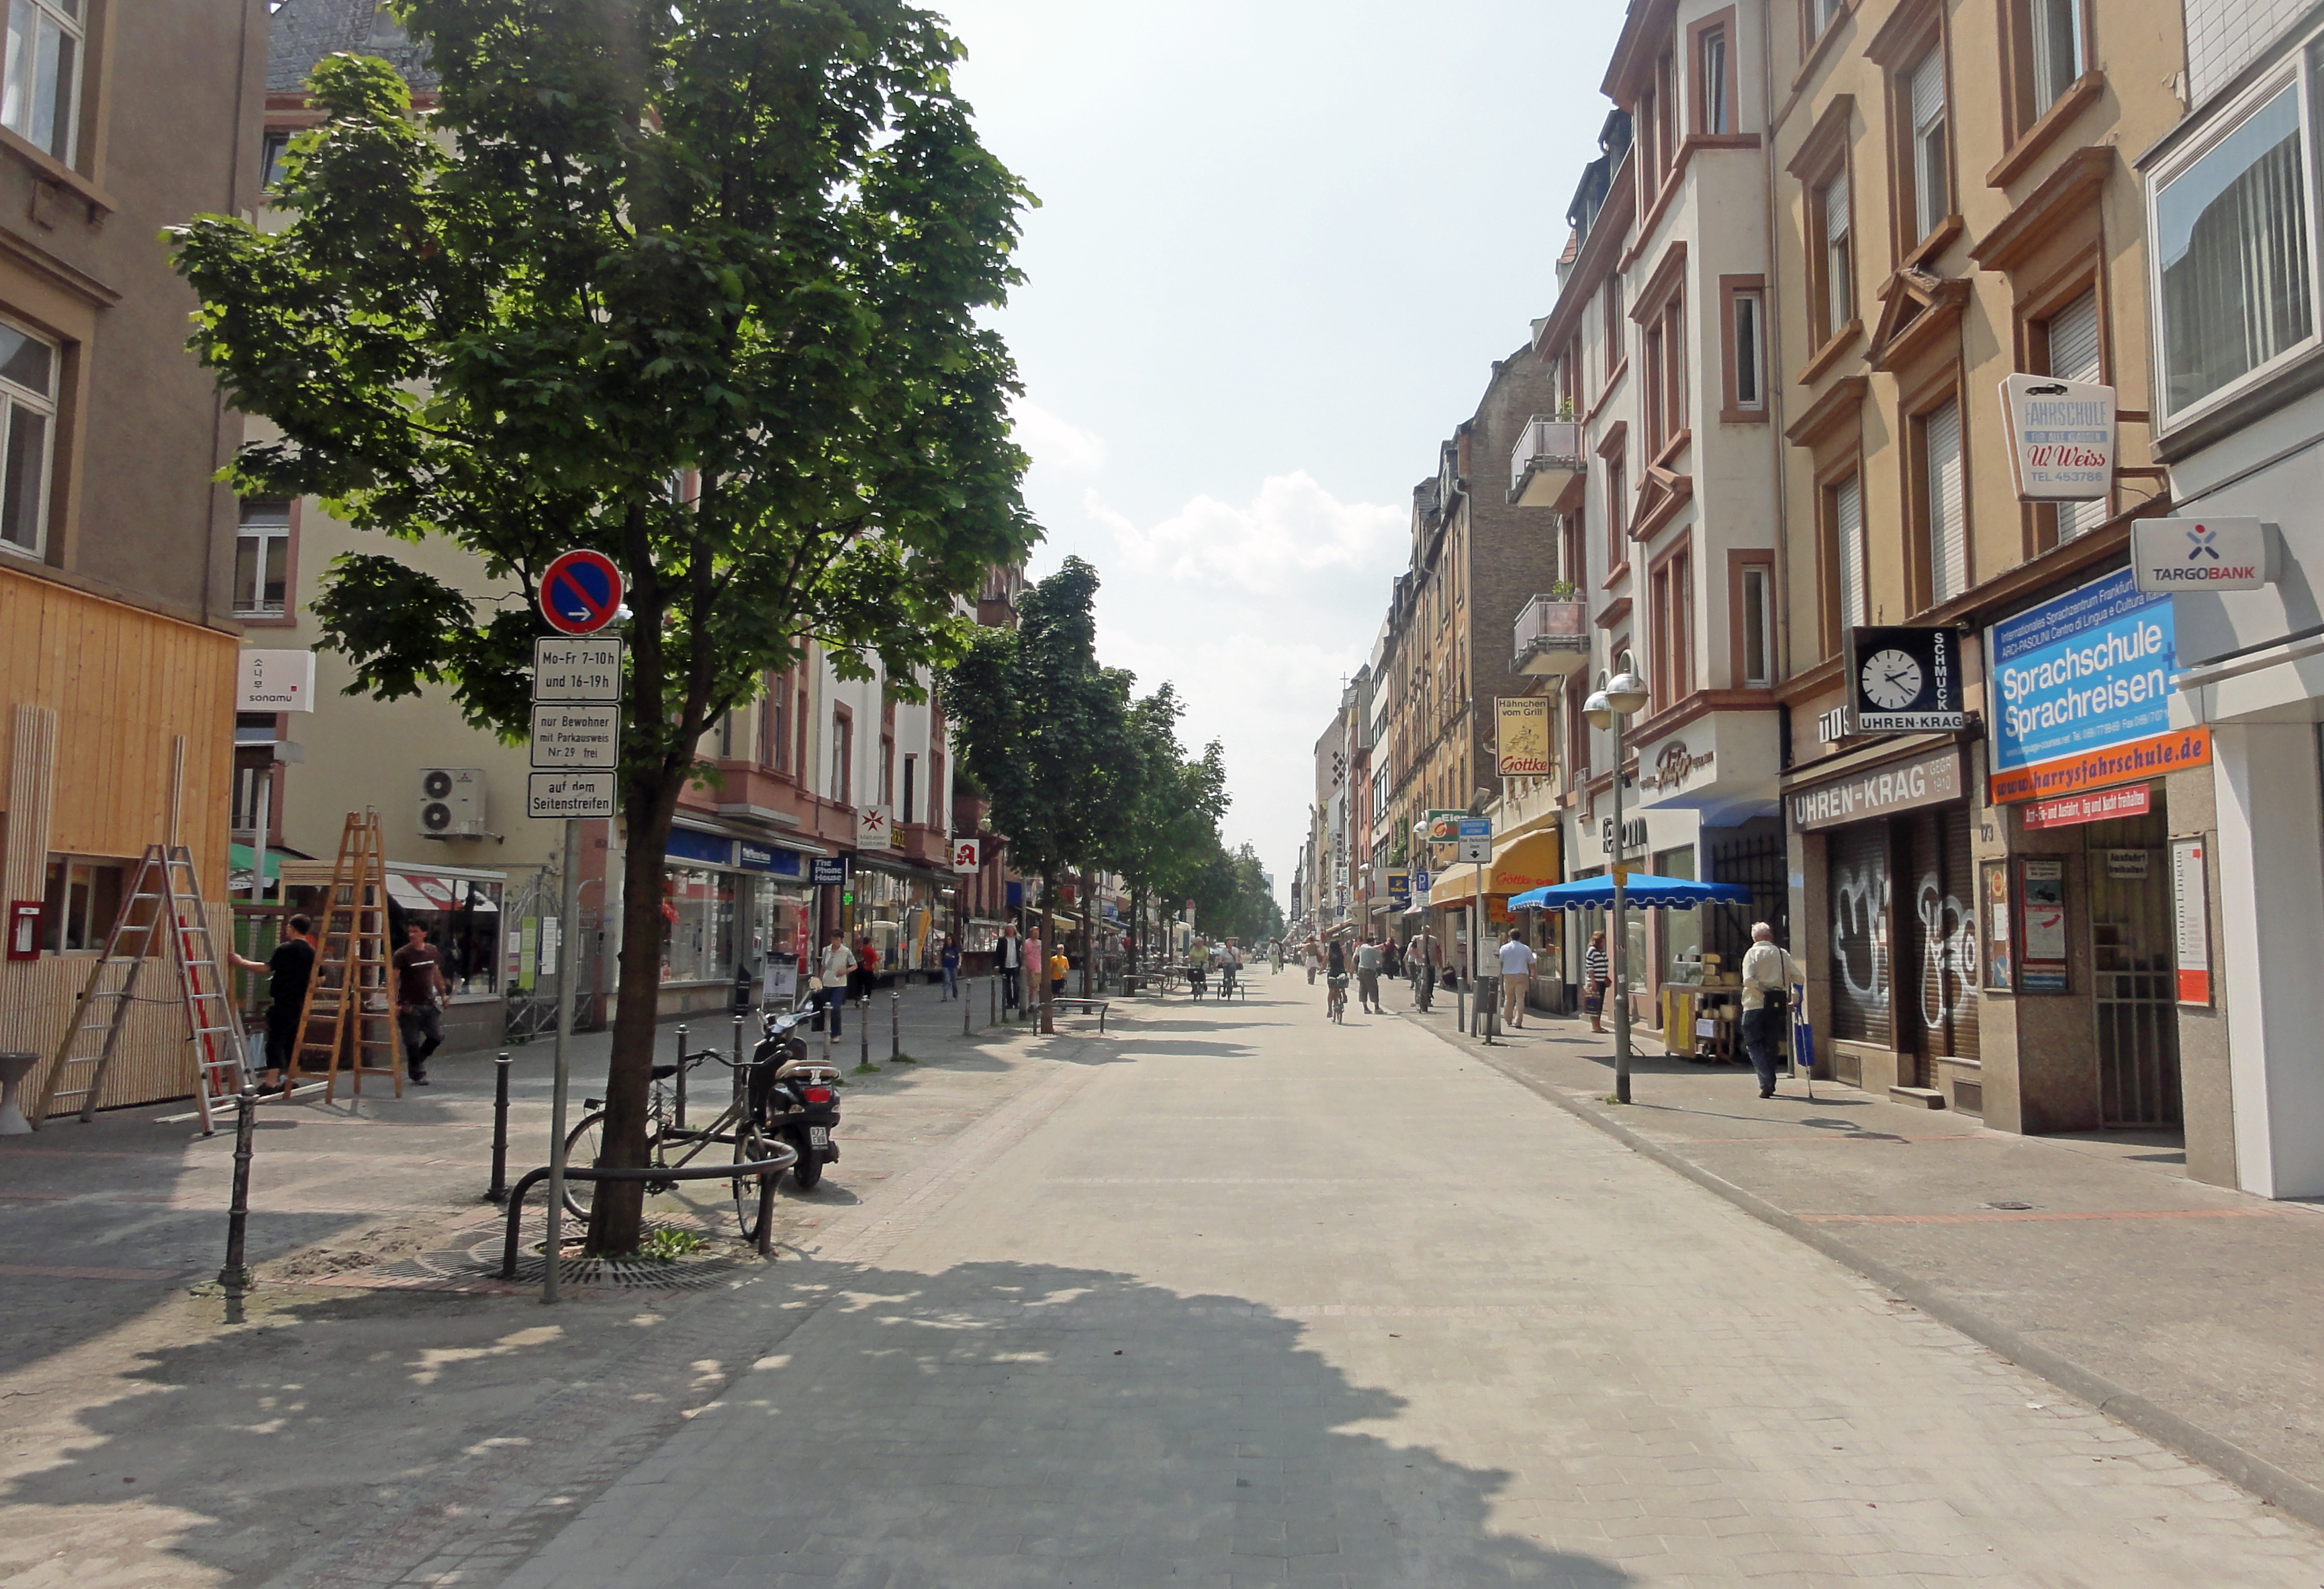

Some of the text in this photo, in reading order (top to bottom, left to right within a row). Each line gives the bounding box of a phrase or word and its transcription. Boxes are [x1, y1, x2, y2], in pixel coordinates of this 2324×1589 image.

[2025, 401, 2107, 426] FAHRSCHULE
[2053, 445, 2106, 467] Weiss
[2153, 567, 2256, 580] TARGOBANK
[2001, 579, 2133, 643] Internationales Sprachzentrum Frankfurt
[2002, 630, 2049, 659] ARCI-PASOLINI
[2051, 622, 2074, 640] Centro
[2075, 618, 2082, 630] di
[2083, 611, 2108, 627] Lingua
[2109, 608, 2114, 616] e
[2116, 594, 2144, 614] Cultura
[543, 651, 577, 665] Mo-Fr
[2003, 620, 2162, 700] Sprachschule
[254, 659, 263, 689] 소나무
[1934, 632, 1949, 710] SCHMUCK
[546, 675, 565, 688] und
[2005, 668, 2164, 742] Sprachreisen
[541, 716, 609, 728] nur Bewohner
[1861, 716, 1962, 729] UHREN-KRAG
[540, 732, 609, 743] mit Parkausweis
[584, 747, 598, 759] frei
[1501, 755, 1547, 773] Göttke
[1930, 757, 1951, 775] GEGR
[1996, 736, 2202, 798] www.harrysfahrschule.de
[549, 781, 595, 793] auf dem
[1934, 775, 1951, 792] 1910
[1795, 764, 1926, 824] UHREN-KRAG
[533, 797, 609, 810] Seitenstreifen
[2048, 805, 2057, 819] und
[2082, 799, 2090, 816] Tag
[2092, 798, 2102, 812] und
[2102, 795, 2117, 811] Nacht
[2118, 790, 2145, 808] freihalten
